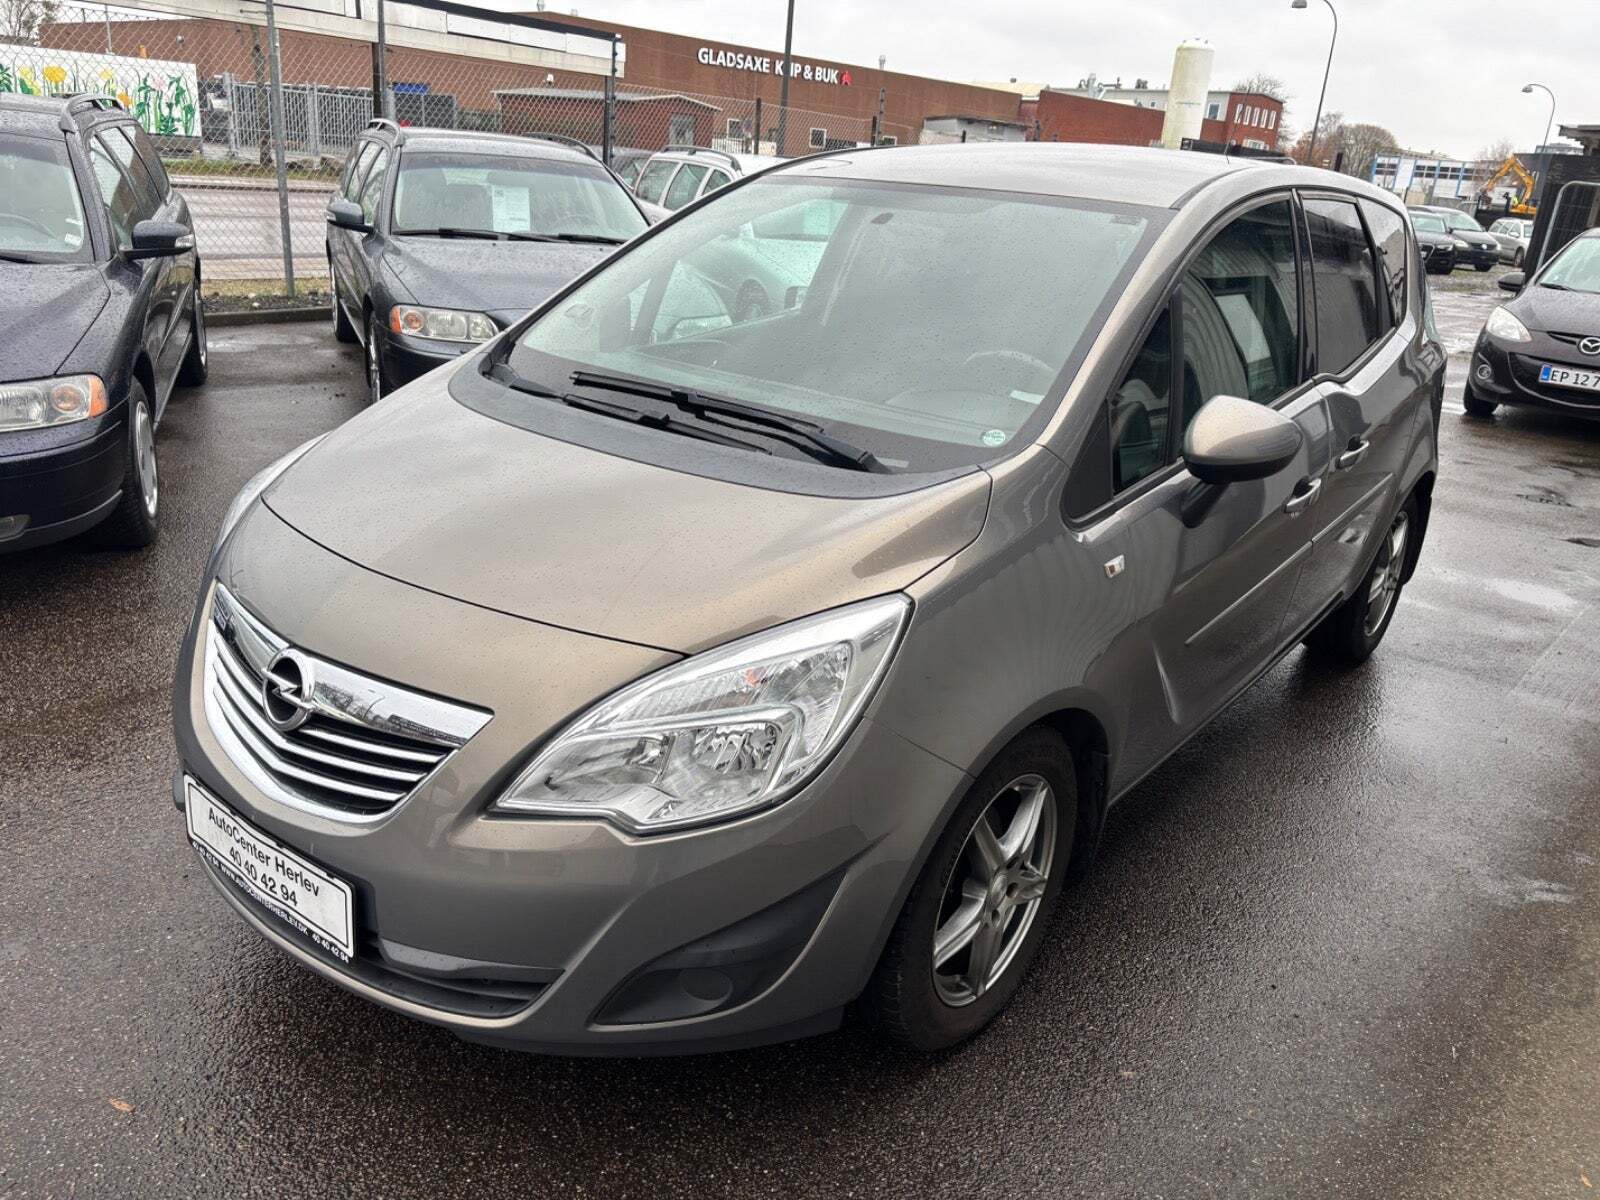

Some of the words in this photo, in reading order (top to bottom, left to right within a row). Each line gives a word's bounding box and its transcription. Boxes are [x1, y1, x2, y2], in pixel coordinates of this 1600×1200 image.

[698, 47, 771, 73] GLADSAXE
[774, 59, 801, 78] KIP
[803, 64, 813, 81] &
[815, 66, 839, 84] BUK
[1551, 370, 1570, 383] EP
[1572, 373, 1590, 387] 12
[208, 807, 271, 867] AutoCenter
[275, 856, 320, 897] Herlev
[229, 846, 242, 868] 40
[244, 860, 258, 881] 40
[261, 873, 278, 895] 42
[281, 884, 298, 907] 94
